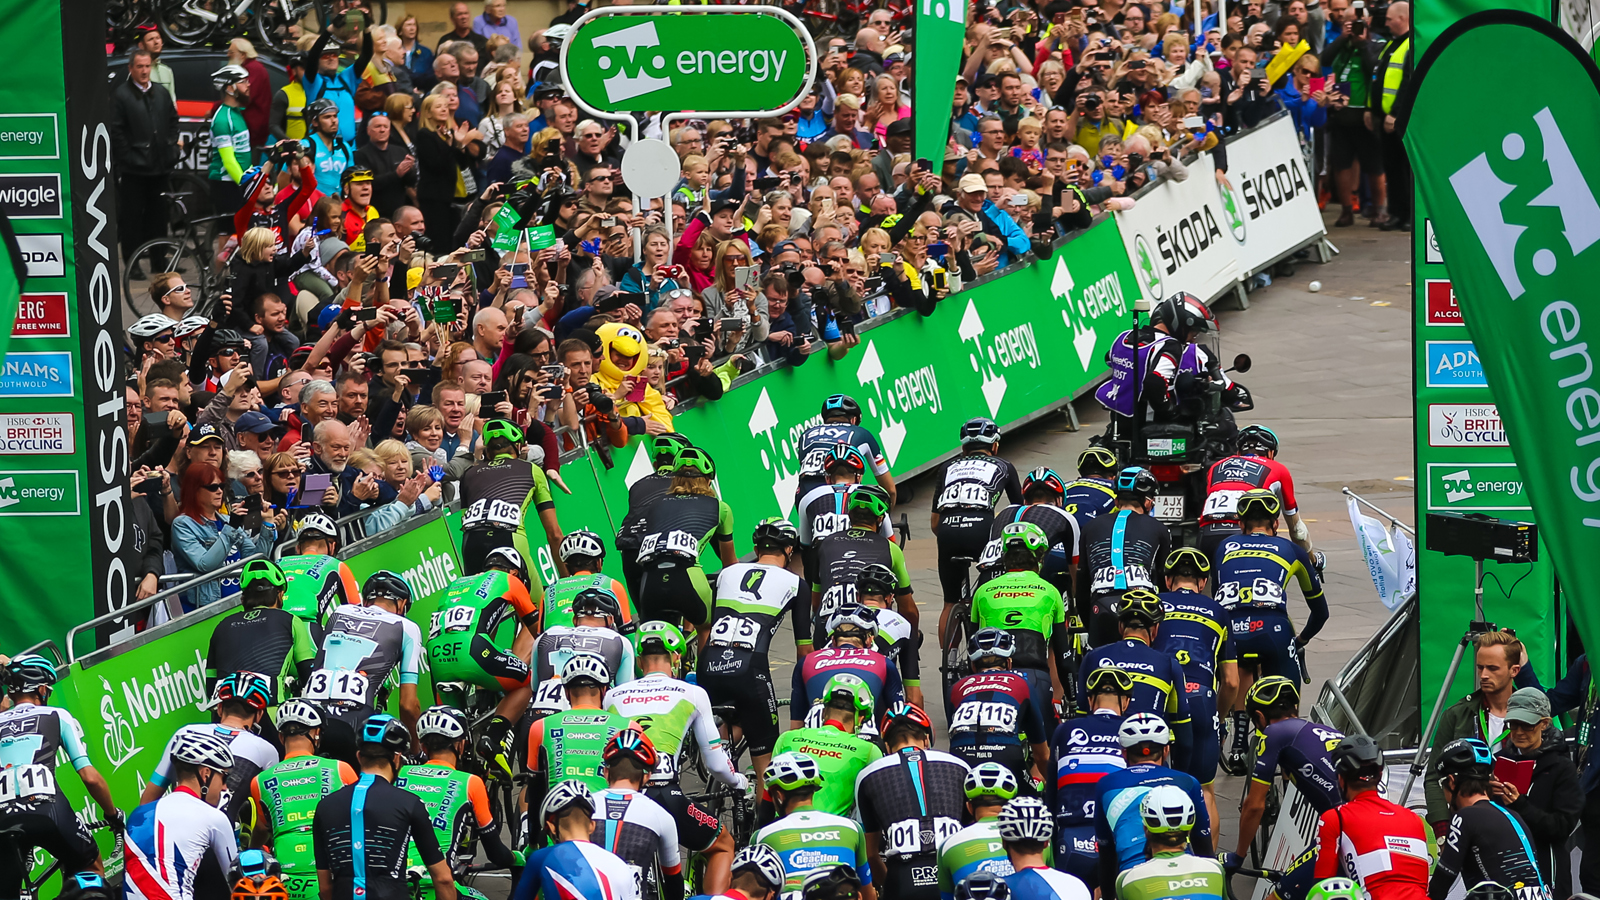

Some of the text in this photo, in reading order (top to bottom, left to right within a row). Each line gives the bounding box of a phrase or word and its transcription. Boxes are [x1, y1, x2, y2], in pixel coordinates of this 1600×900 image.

[676, 49, 788, 82] energy
[0, 130, 44, 147] energy
[319, 158, 347, 174] sky
[0, 186, 56, 208] wiggle
[1240, 158, 1309, 220] ŠKODA
[1155, 203, 1223, 276] ŠKODA
[21, 251, 59, 263] ODA
[1082, 270, 1127, 321] energy
[15, 300, 46, 320] ERG
[38, 322, 61, 330] WINE
[995, 321, 1041, 369] energy
[1435, 350, 1481, 375] ADN
[1452, 370, 1483, 378] SOUTH
[0, 380, 48, 389] OUTHWOLD
[894, 364, 943, 415] energy
[1464, 407, 1490, 417] HSBC
[7, 417, 61, 426] HSBC UK
[7, 427, 62, 439] BRITISH
[806, 426, 848, 439] sky
[7, 439, 63, 451] CYCLING
[1172, 442, 1185, 451] 246
[21, 486, 65, 501] energy
[965, 487, 988, 502] 113
[1476, 480, 1523, 495] energy
[1162, 497, 1183, 507] AJX
[1209, 494, 1229, 509] 12
[464, 502, 482, 520] 85
[492, 502, 519, 521] 185
[1162, 507, 1182, 517] 473
[815, 515, 835, 533] 04
[671, 533, 697, 551] 186
[1241, 543, 1279, 552] ORICA
[1096, 566, 1115, 583] 46
[985, 583, 1047, 593] cannondale
[993, 591, 1035, 599] drapac
[1254, 579, 1283, 598] 53
[446, 607, 473, 623] 161
[1176, 604, 1214, 617] ORICA
[432, 642, 463, 658] CSF
[706, 658, 743, 673] Nederburg
[814, 657, 876, 671] Condor
[1116, 662, 1155, 672] ORICA
[337, 673, 365, 696] 13
[975, 675, 1015, 684] JLT
[612, 685, 686, 698] cannondale
[962, 683, 1012, 696] Condor
[622, 695, 670, 705] drapac
[956, 705, 975, 721] 15
[984, 705, 1014, 726] 115
[565, 748, 600, 756] CIPOLLINI
[791, 737, 858, 753] cannondale
[799, 744, 843, 760] drapac
[550, 728, 564, 779] BARDIANI
[655, 754, 671, 774] 23
[22, 768, 49, 788] 11
[1312, 773, 1335, 792] ORICA
[263, 777, 285, 827] BARDIANI
[284, 793, 319, 803] CIPOLLINI
[432, 779, 458, 831] BARDIANI
[1110, 788, 1138, 819] BIKE
[687, 802, 719, 830] drapac
[894, 824, 915, 848] 01
[939, 822, 959, 839] 10
[796, 853, 839, 864] Reaction
[1285, 846, 1319, 876] SCOT
[984, 864, 1015, 875] Reac
[1344, 852, 1361, 887] SOU
[284, 879, 318, 893] SF
